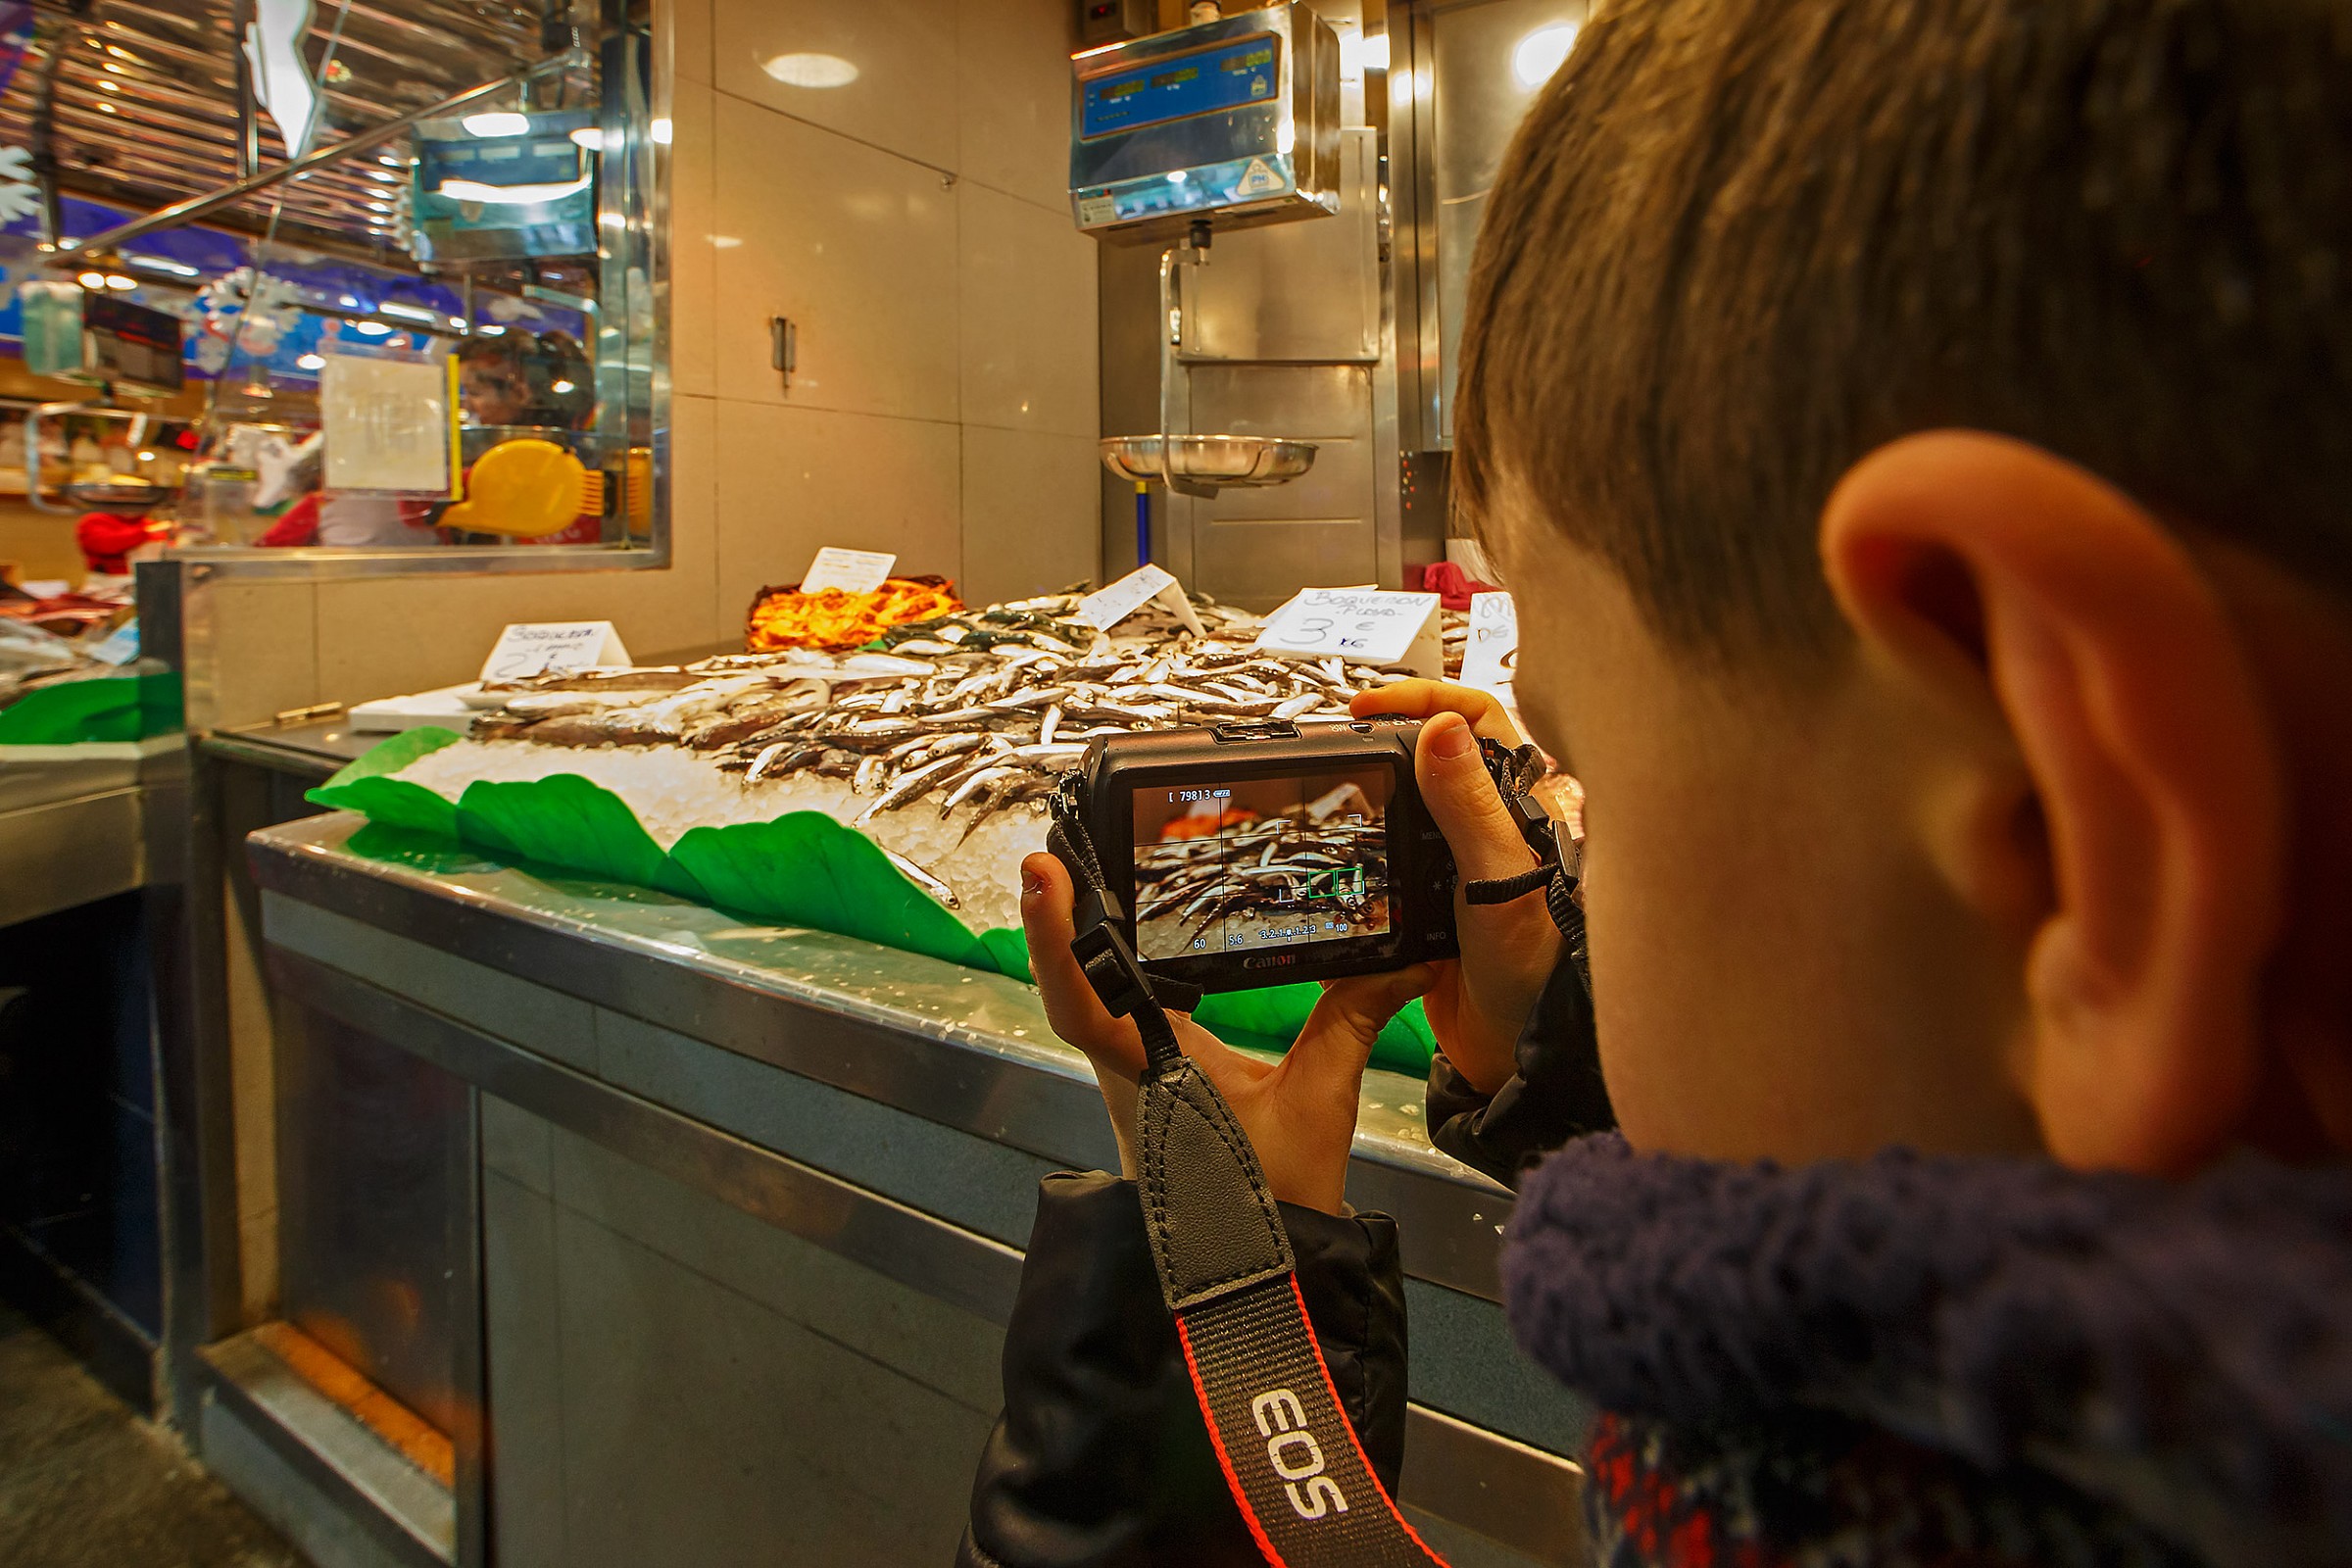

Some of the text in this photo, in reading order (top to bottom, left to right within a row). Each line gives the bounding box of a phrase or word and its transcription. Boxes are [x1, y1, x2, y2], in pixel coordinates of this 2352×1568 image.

[1279, 617, 1334, 645] 3
[1194, 938, 1206, 950] 60
[1228, 934, 1244, 946] 5.6
[1335, 922, 1348, 933] 100
[1426, 931, 1446, 941] INFO
[1243, 954, 1297, 970] Canon
[1251, 1388, 1349, 1520] EOS
